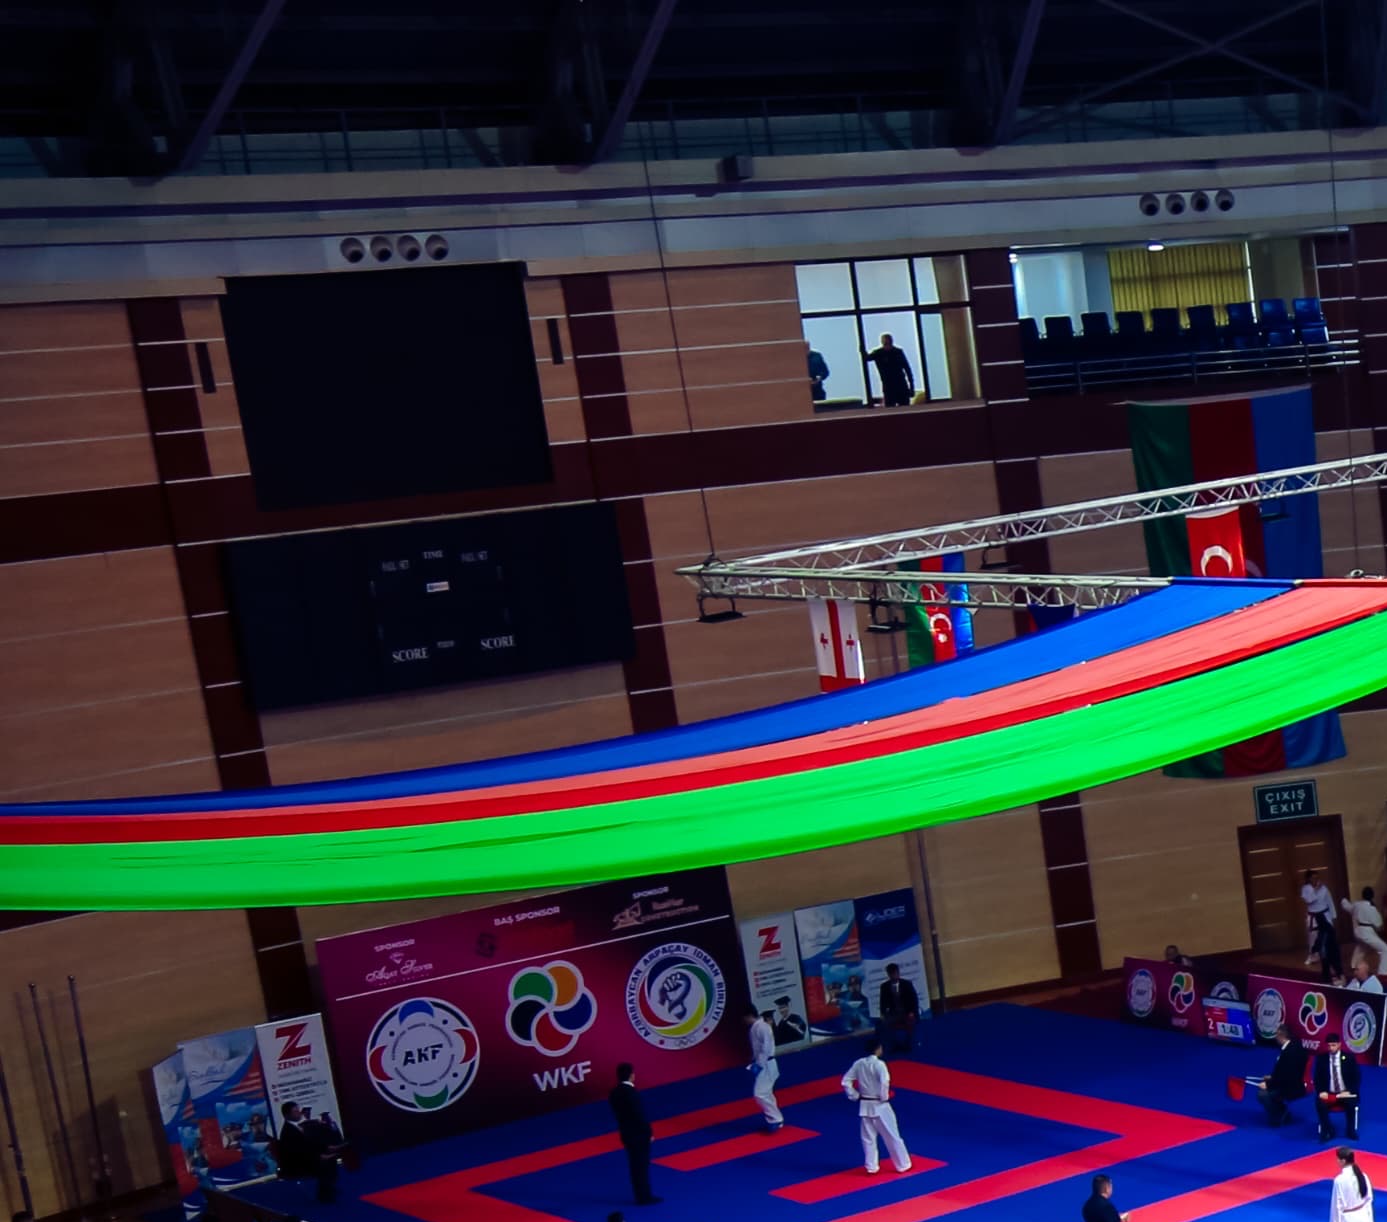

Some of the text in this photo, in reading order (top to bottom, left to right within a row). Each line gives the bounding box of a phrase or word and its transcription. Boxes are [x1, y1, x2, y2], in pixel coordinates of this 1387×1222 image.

[481, 635, 514, 650] SCORE
[392, 648, 428, 663] SCORE
[1269, 801, 1304, 814] EXIT
[632, 886, 670, 899] SPONSOR
[515, 906, 561, 922] SPONSOR
[374, 939, 415, 952] SPONSOR
[1207, 1017, 1214, 1029] 2
[1301, 1039, 1320, 1050] WKF
[403, 1043, 443, 1066] AKF
[277, 1057, 312, 1071] ZENITH
[533, 1060, 592, 1092] WKF
